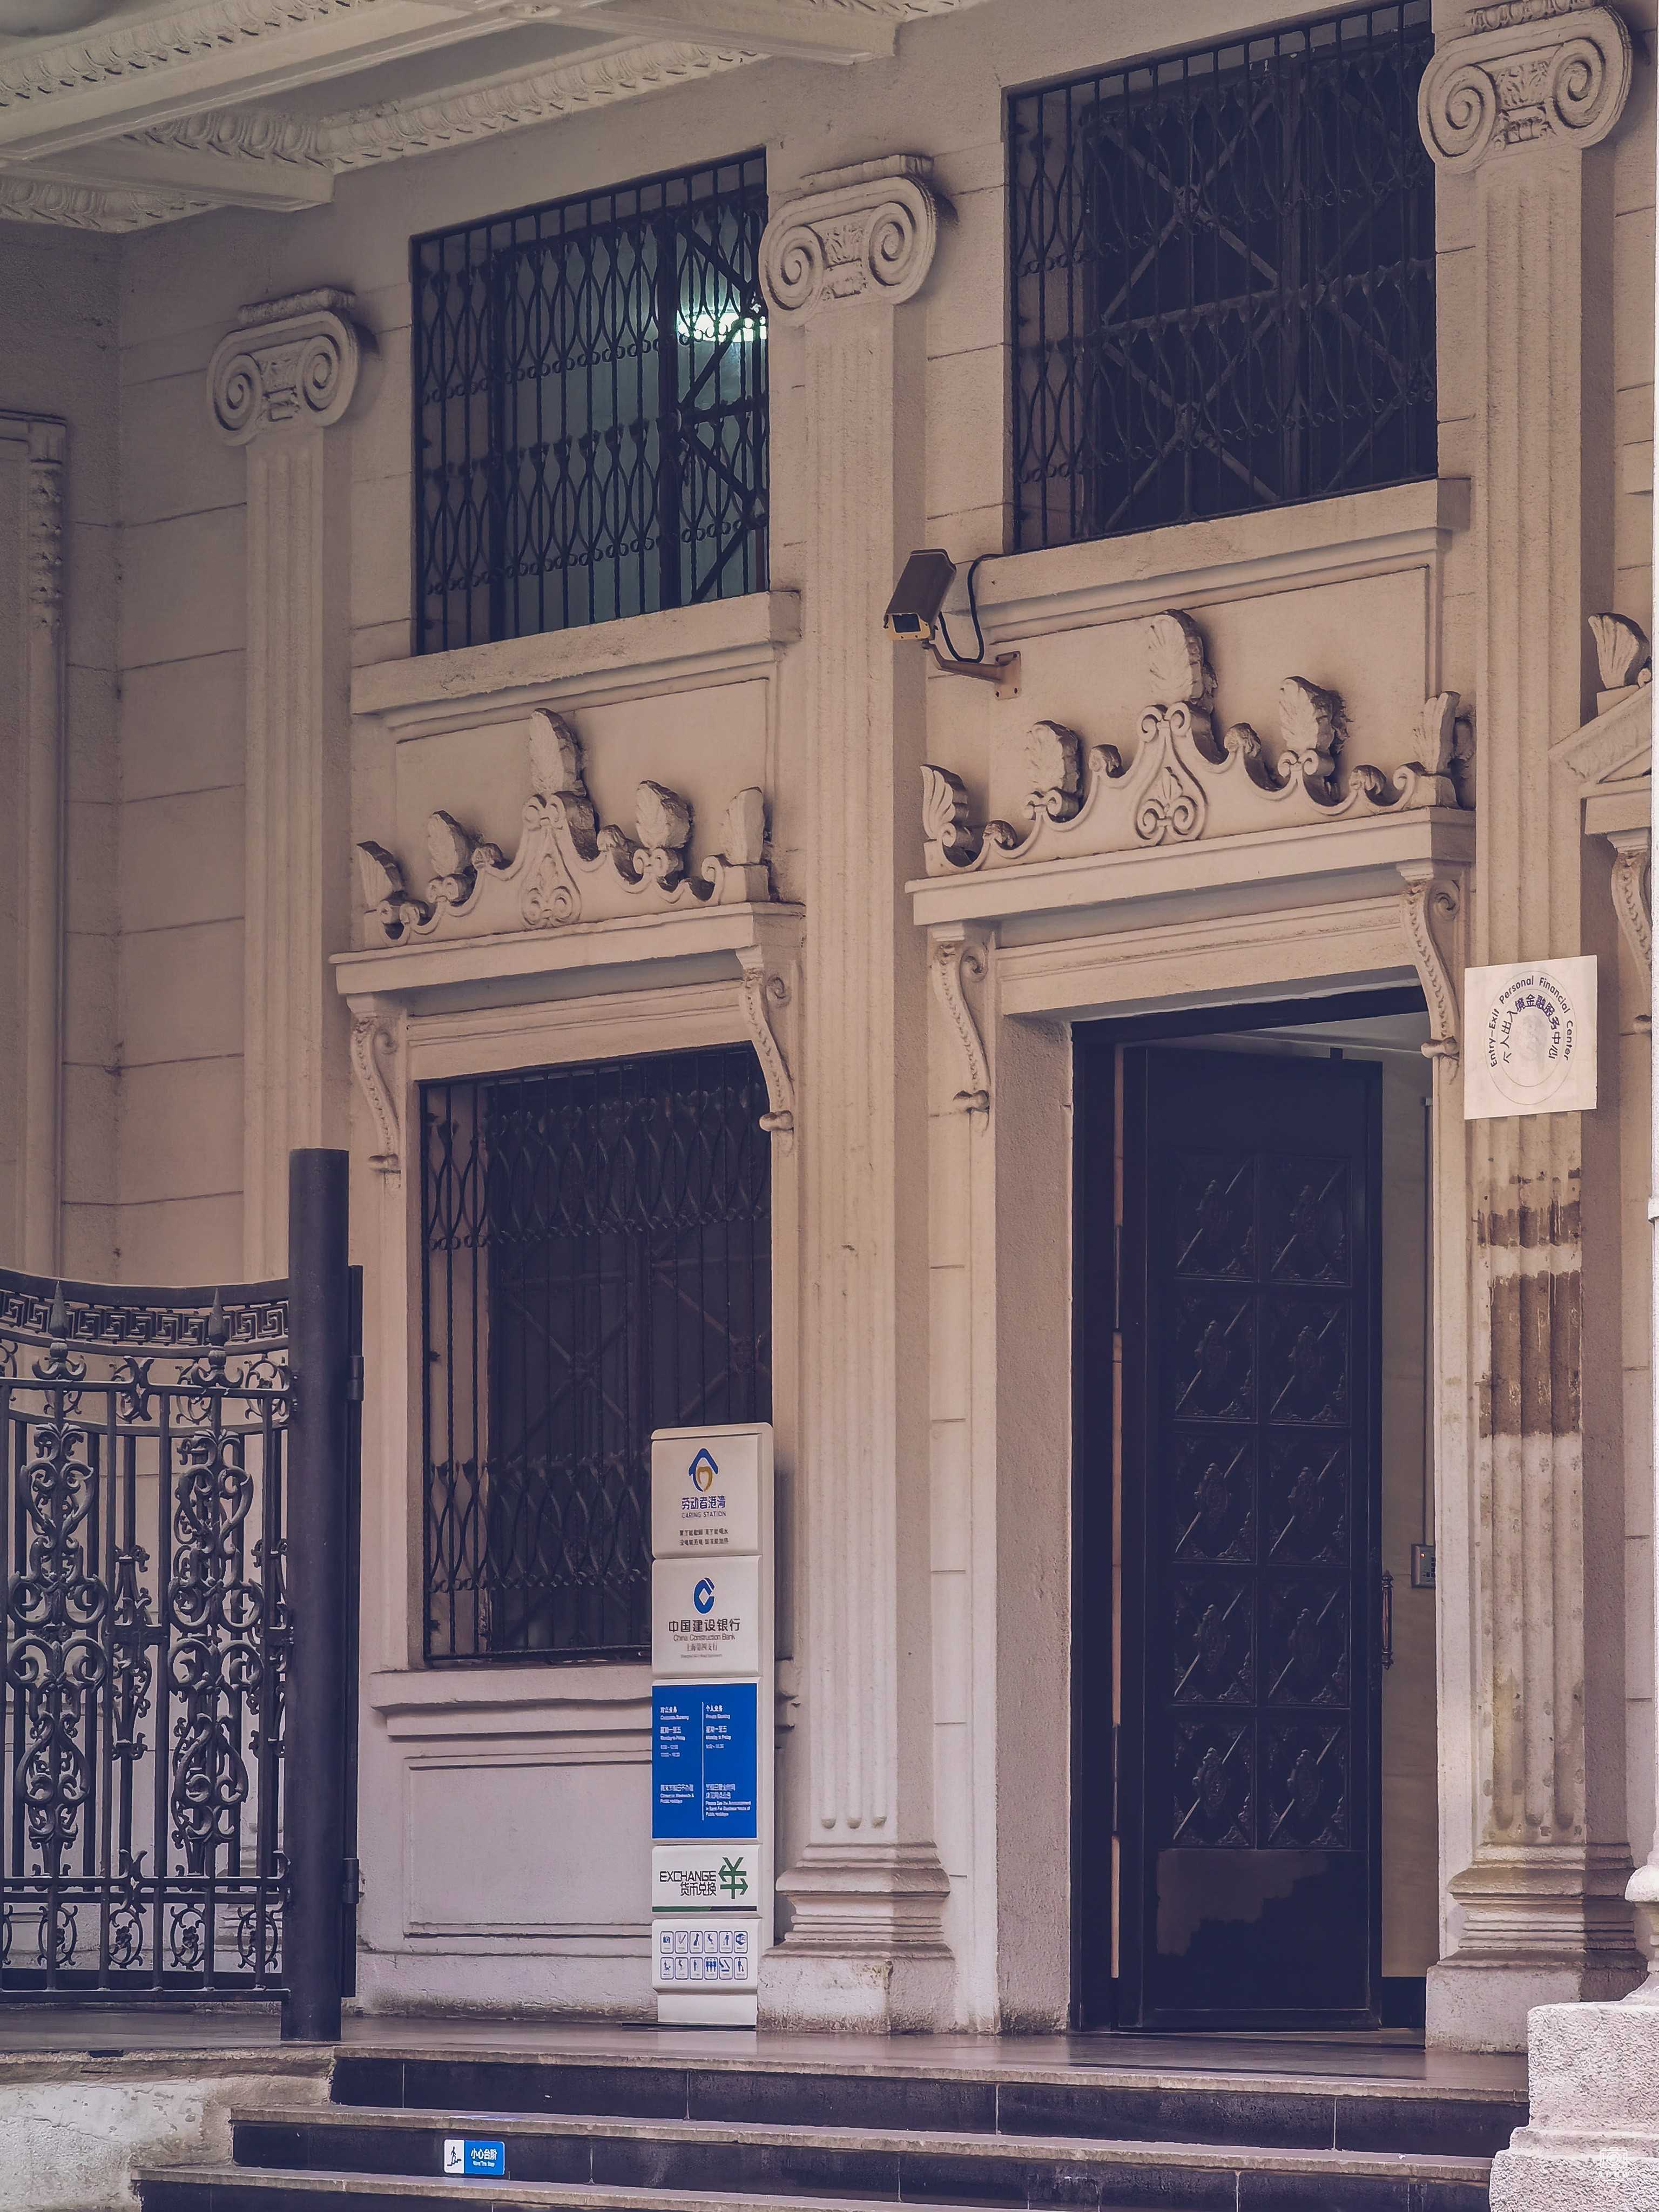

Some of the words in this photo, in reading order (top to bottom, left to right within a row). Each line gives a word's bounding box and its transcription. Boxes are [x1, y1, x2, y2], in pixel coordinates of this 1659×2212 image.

[1488, 1008, 1500, 1067] Entry-Exit
[1499, 975, 1534, 1004] Personal
[1539, 977, 1570, 1014] Financial
[1563, 1020, 1573, 1061] Center
[681, 1495, 726, 1510] 劳动者港湾
[669, 1618, 740, 1633] 中国建设银行
[722, 1633, 736, 1641] Bank
[659, 1871, 717, 1882] EXCHANGE
[680, 1881, 717, 1896] 货币兑换
[471, 2148, 497, 2160] 小心台阶
